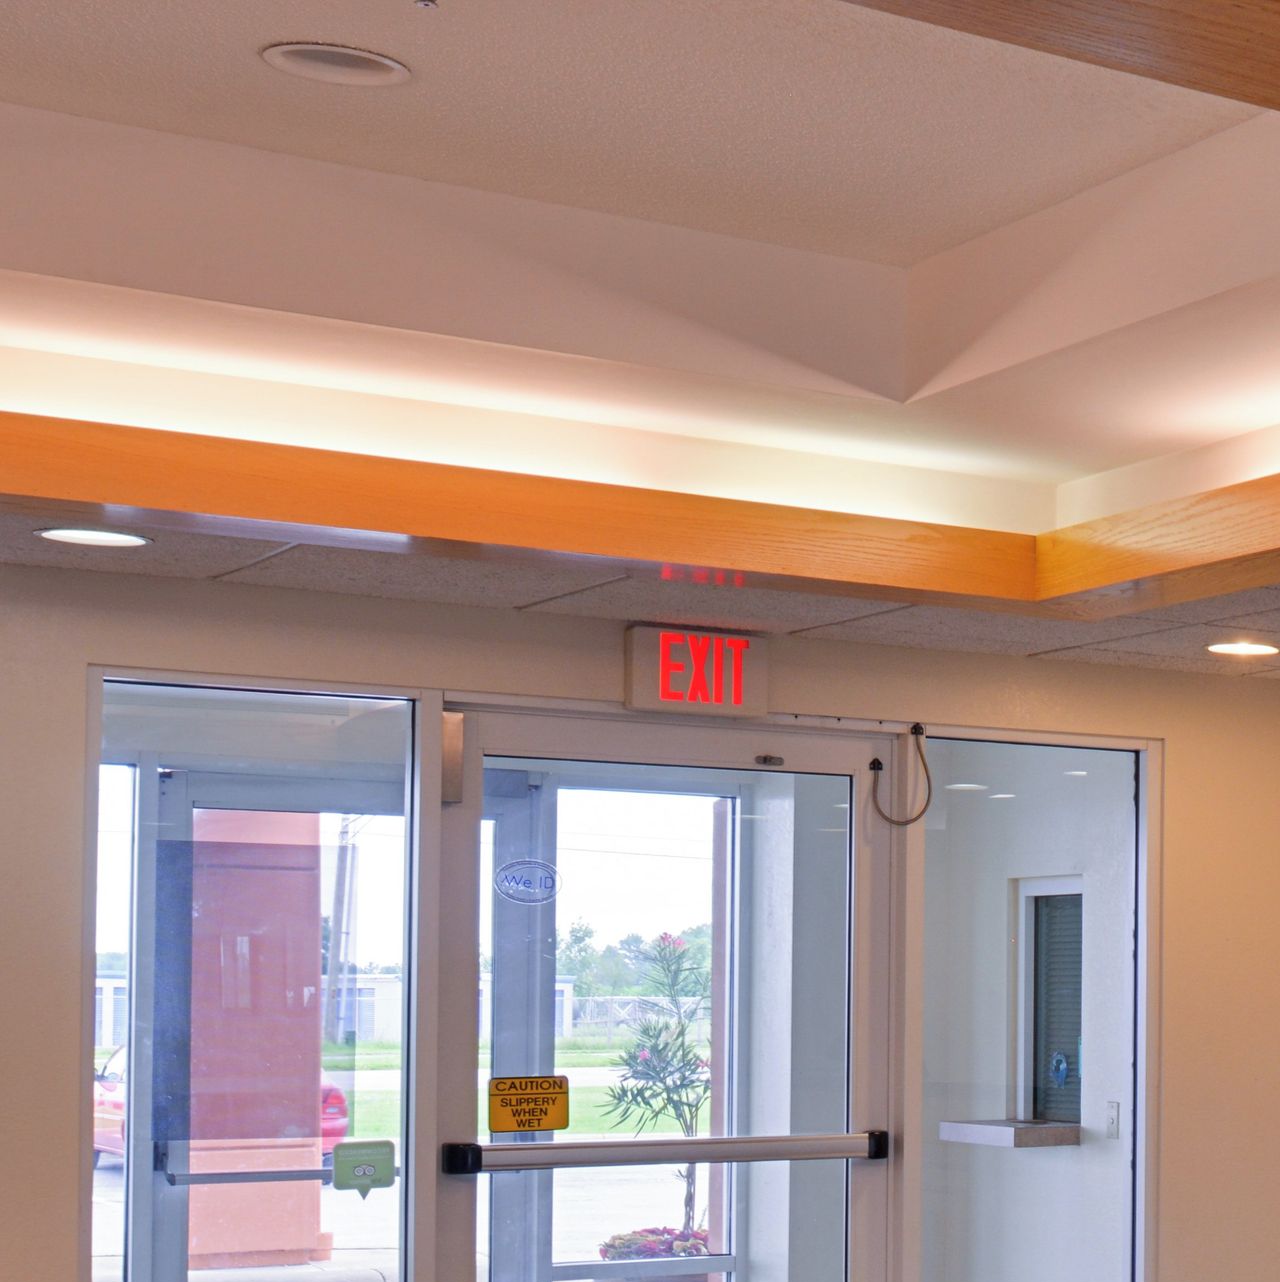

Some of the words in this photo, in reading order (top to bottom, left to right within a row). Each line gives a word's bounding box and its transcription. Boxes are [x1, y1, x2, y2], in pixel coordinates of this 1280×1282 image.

[659, 632, 749, 705] EXIT
[501, 873, 532, 888] We
[539, 876, 555, 889] ID
[495, 1080, 563, 1092] CAUTION
[500, 1096, 558, 1108] SLIPPERY
[511, 1107, 548, 1118] WHEN
[516, 1118, 543, 1128] WET
